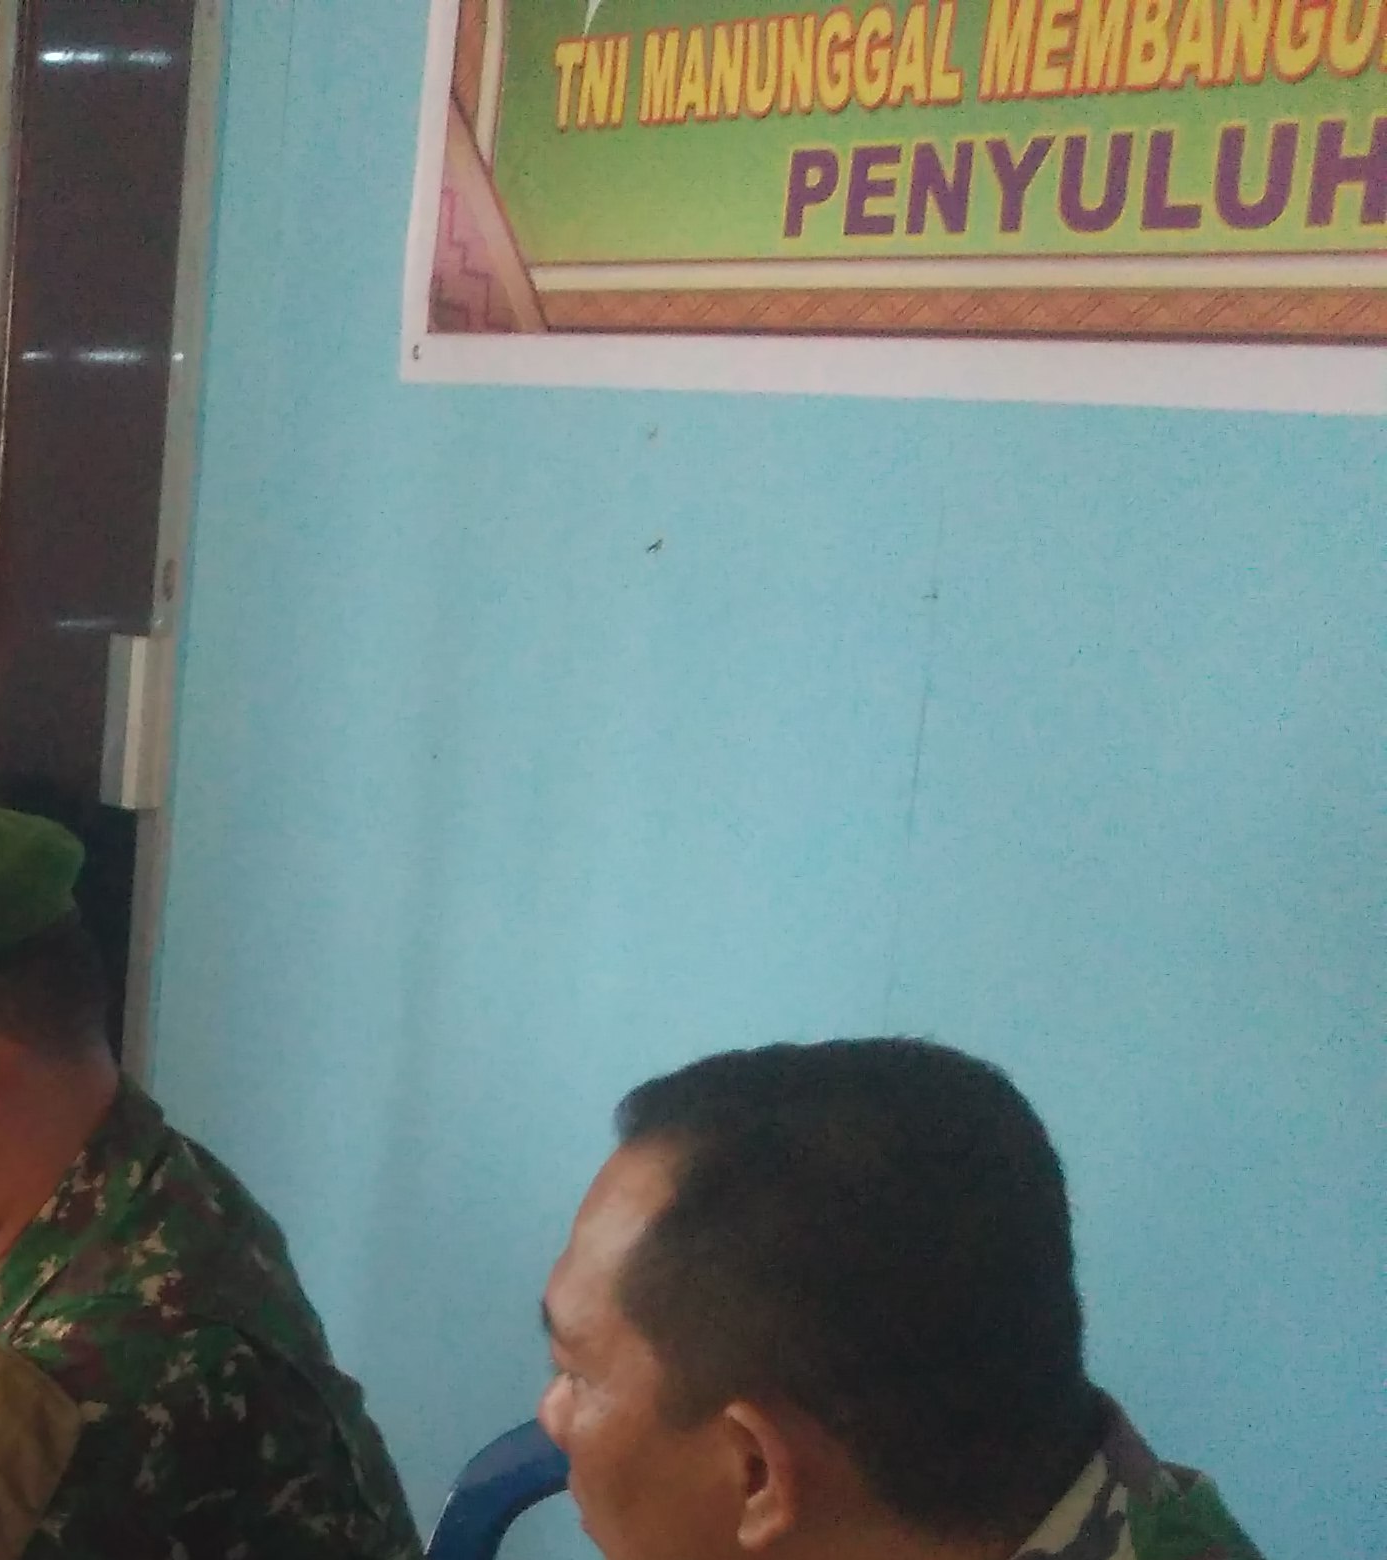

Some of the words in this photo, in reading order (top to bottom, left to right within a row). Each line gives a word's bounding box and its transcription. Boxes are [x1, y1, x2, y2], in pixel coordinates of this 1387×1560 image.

[554, 34, 630, 133] TNI
[638, 0, 965, 126] MANUNGGAL
[978, 0, 1387, 102] MEMBANGU
[782, 115, 1387, 239] PENYULUH
